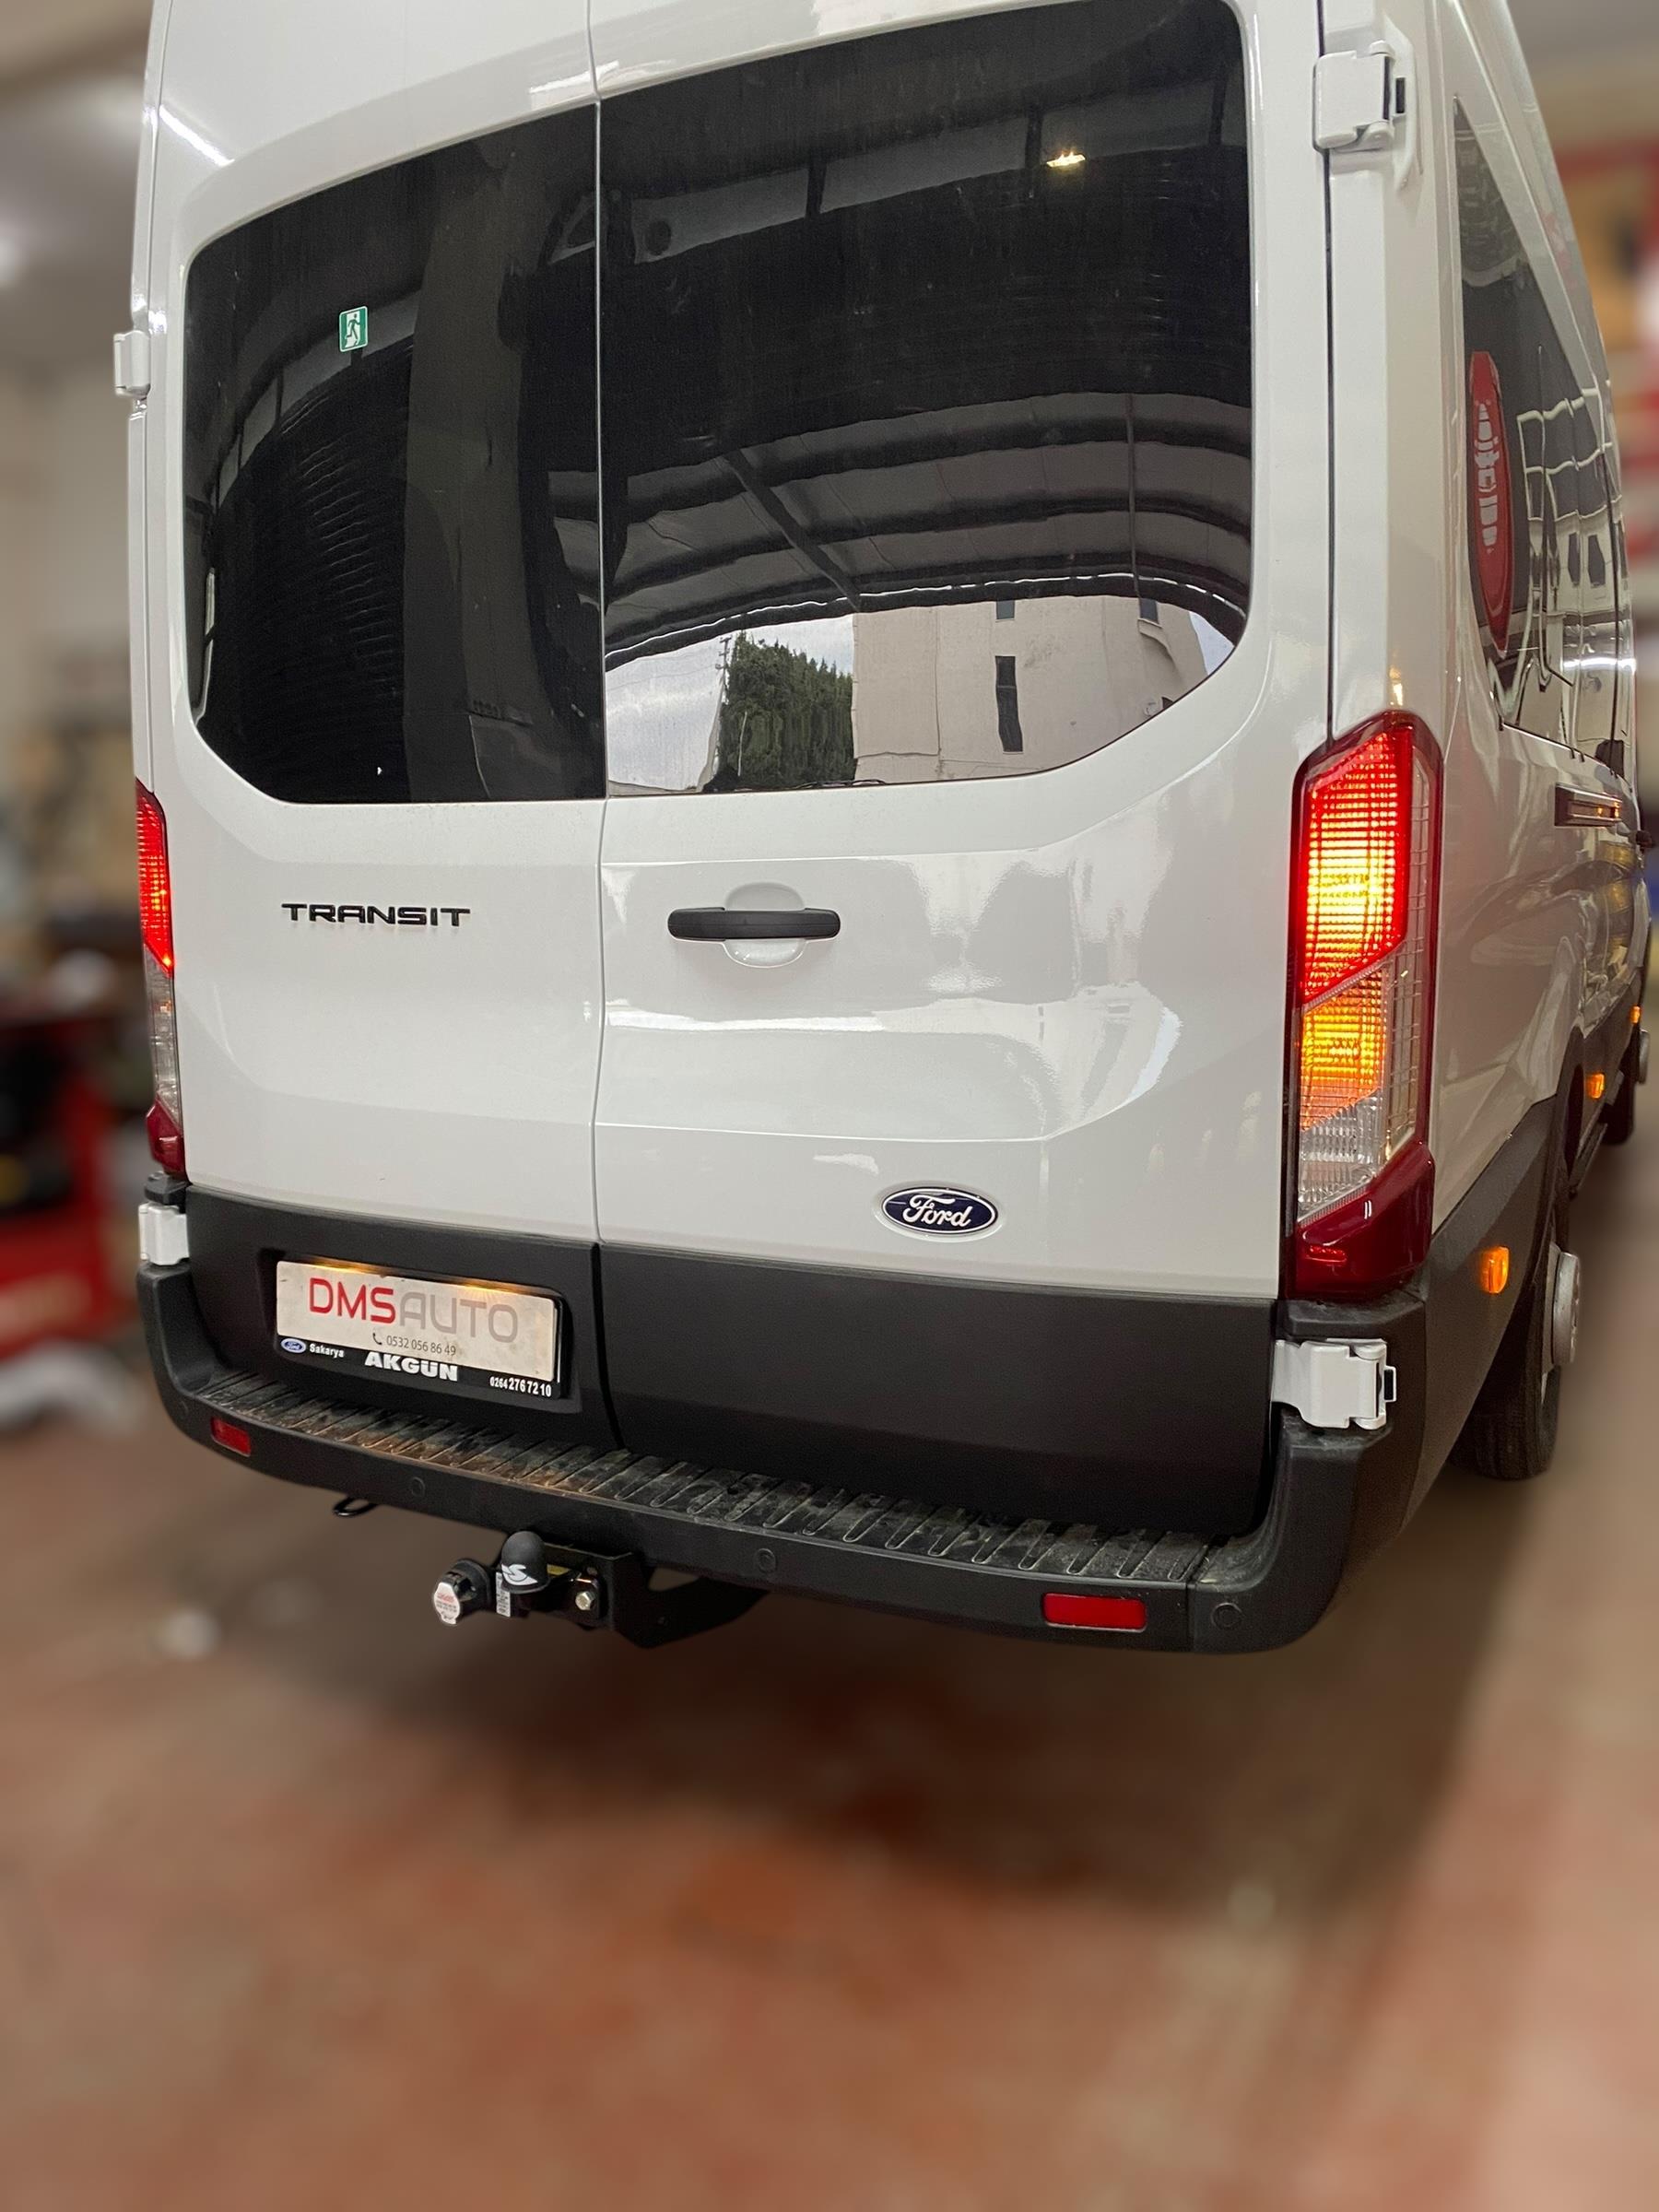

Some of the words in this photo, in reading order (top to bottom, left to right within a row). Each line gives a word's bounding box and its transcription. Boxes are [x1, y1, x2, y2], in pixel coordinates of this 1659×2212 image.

[281, 903, 470, 926] TRANSIT
[902, 1194, 973, 1227] Ford
[309, 1343, 345, 1359] Sakarya
[386, 1335, 409, 1349] 0532
[411, 1339, 429, 1352] 056
[430, 1342, 442, 1354] 86
[444, 1345, 457, 1356] 49
